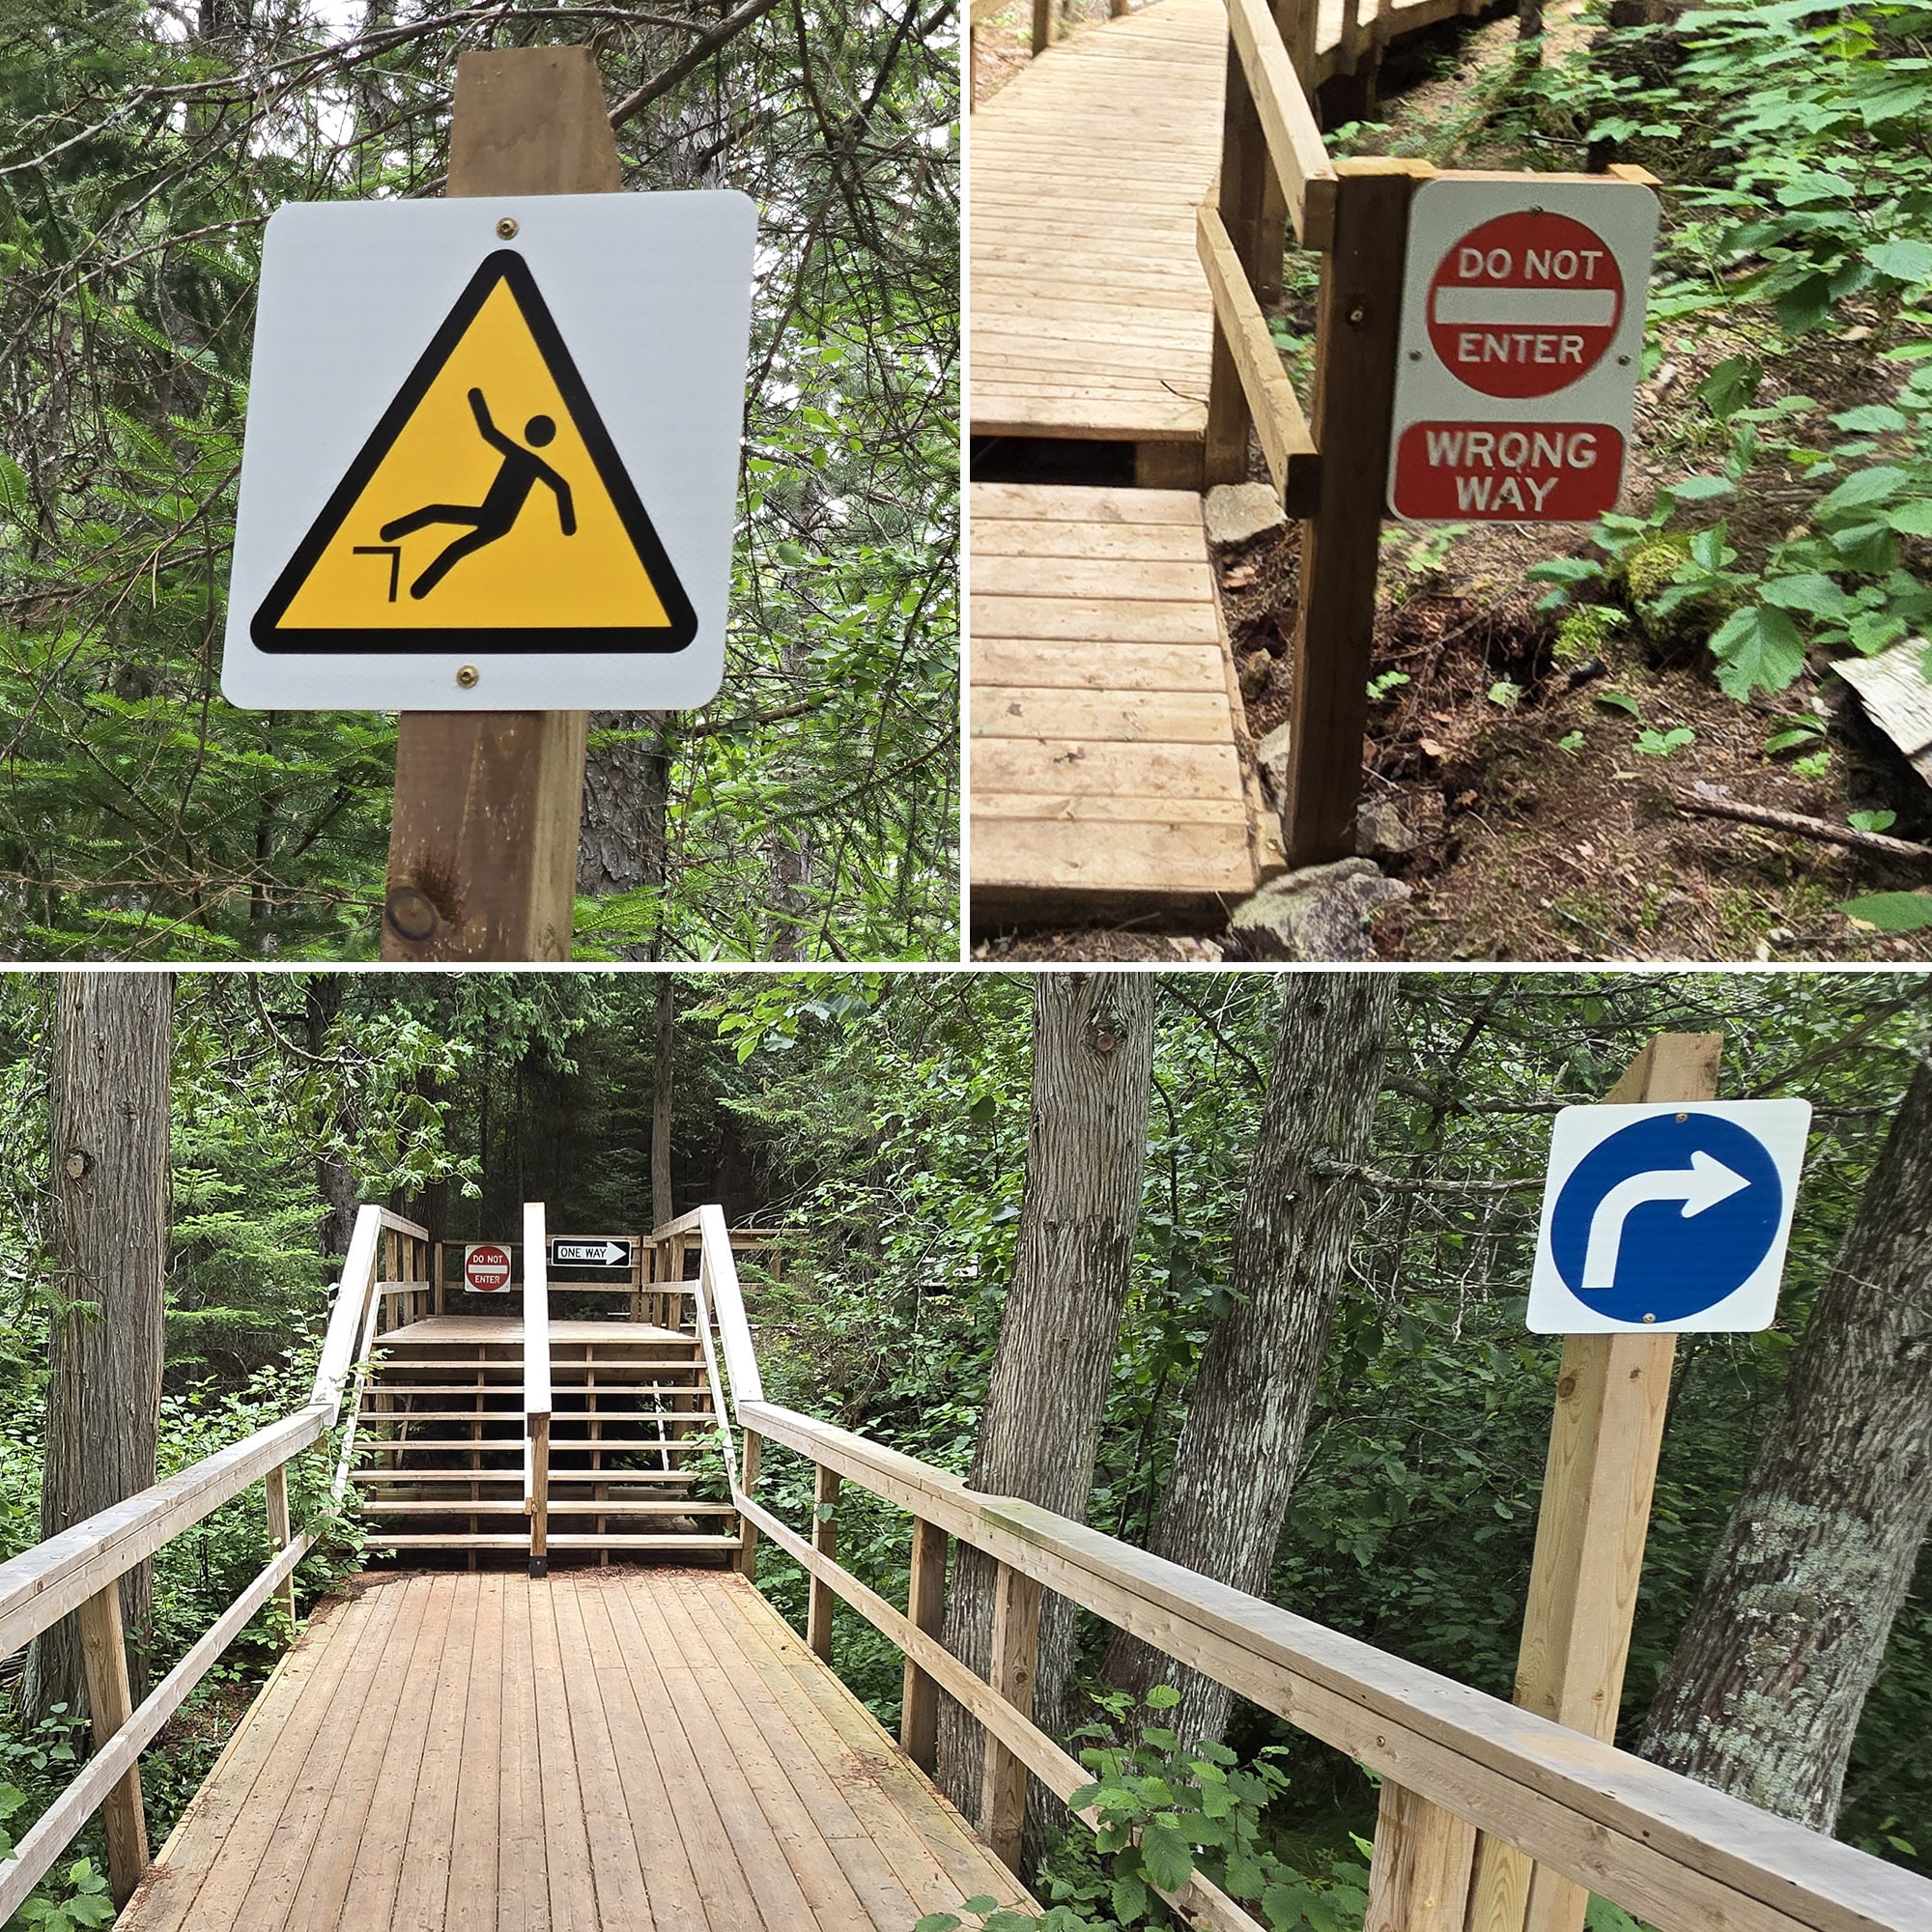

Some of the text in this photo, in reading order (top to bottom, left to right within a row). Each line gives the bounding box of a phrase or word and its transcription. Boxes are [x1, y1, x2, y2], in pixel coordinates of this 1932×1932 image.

[1459, 247, 1603, 281] DO NOT
[1458, 332, 1585, 364] ENTER
[1426, 431, 1597, 469] WRONG
[1456, 476, 1559, 511] WAY
[472, 1254, 503, 1264] DO NOT
[560, 1247, 607, 1259] ONE WAY
[474, 1275, 500, 1284] ENTER
